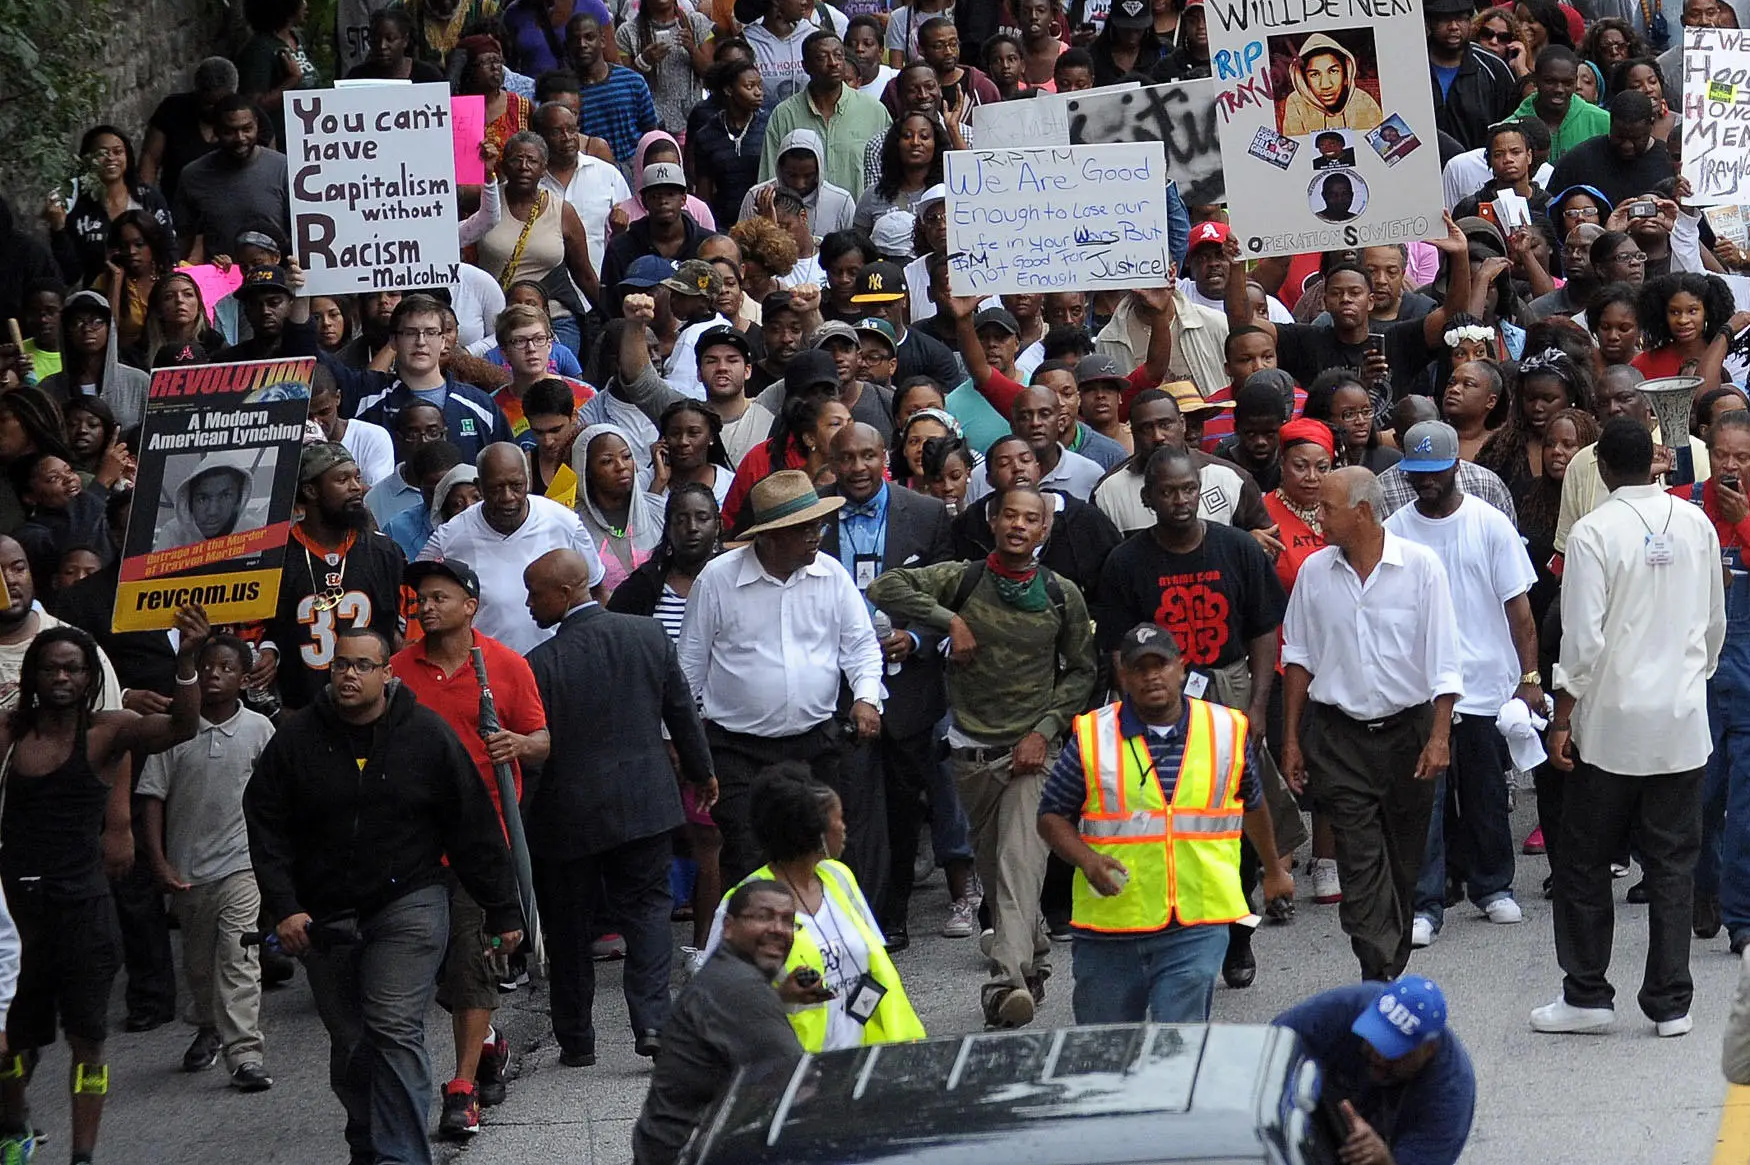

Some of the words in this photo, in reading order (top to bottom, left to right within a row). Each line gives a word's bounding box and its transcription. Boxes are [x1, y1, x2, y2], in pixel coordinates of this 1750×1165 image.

[1685, 29, 1716, 51] I
[1213, 40, 1263, 81] RIP
[293, 97, 365, 135] You
[375, 103, 448, 132] can't
[303, 139, 378, 162] have
[293, 162, 450, 211] Capitalism
[947, 153, 1008, 197] We
[1018, 162, 1078, 192] Are
[1081, 156, 1150, 183] Good
[361, 200, 443, 222] without
[954, 201, 1040, 231] Enough
[1044, 203, 1067, 220] to
[1072, 203, 1107, 219] Lose
[1114, 199, 1150, 214] our
[296, 213, 421, 270] Racism
[957, 230, 999, 252] Life
[1006, 233, 1024, 248] in
[1029, 235, 1070, 253] your
[1118, 220, 1162, 241] But
[1248, 228, 1341, 253] OPERATION
[1343, 216, 1429, 247] SOWETO
[868, 273, 883, 290] NY
[968, 260, 1008, 287] not
[1013, 253, 1050, 268] Good
[1017, 271, 1077, 286] Enough
[1086, 248, 1168, 280] Justice!
[150, 358, 316, 398] REVOLUTION
[148, 428, 230, 450] American
[232, 423, 302, 446] Lynching
[187, 412, 202, 431] A
[204, 409, 269, 429] Modern
[147, 547, 190, 565] Outrage
[226, 529, 268, 547] Murder
[160, 555, 204, 573] Trayvon
[135, 580, 260, 612] revcom.us
